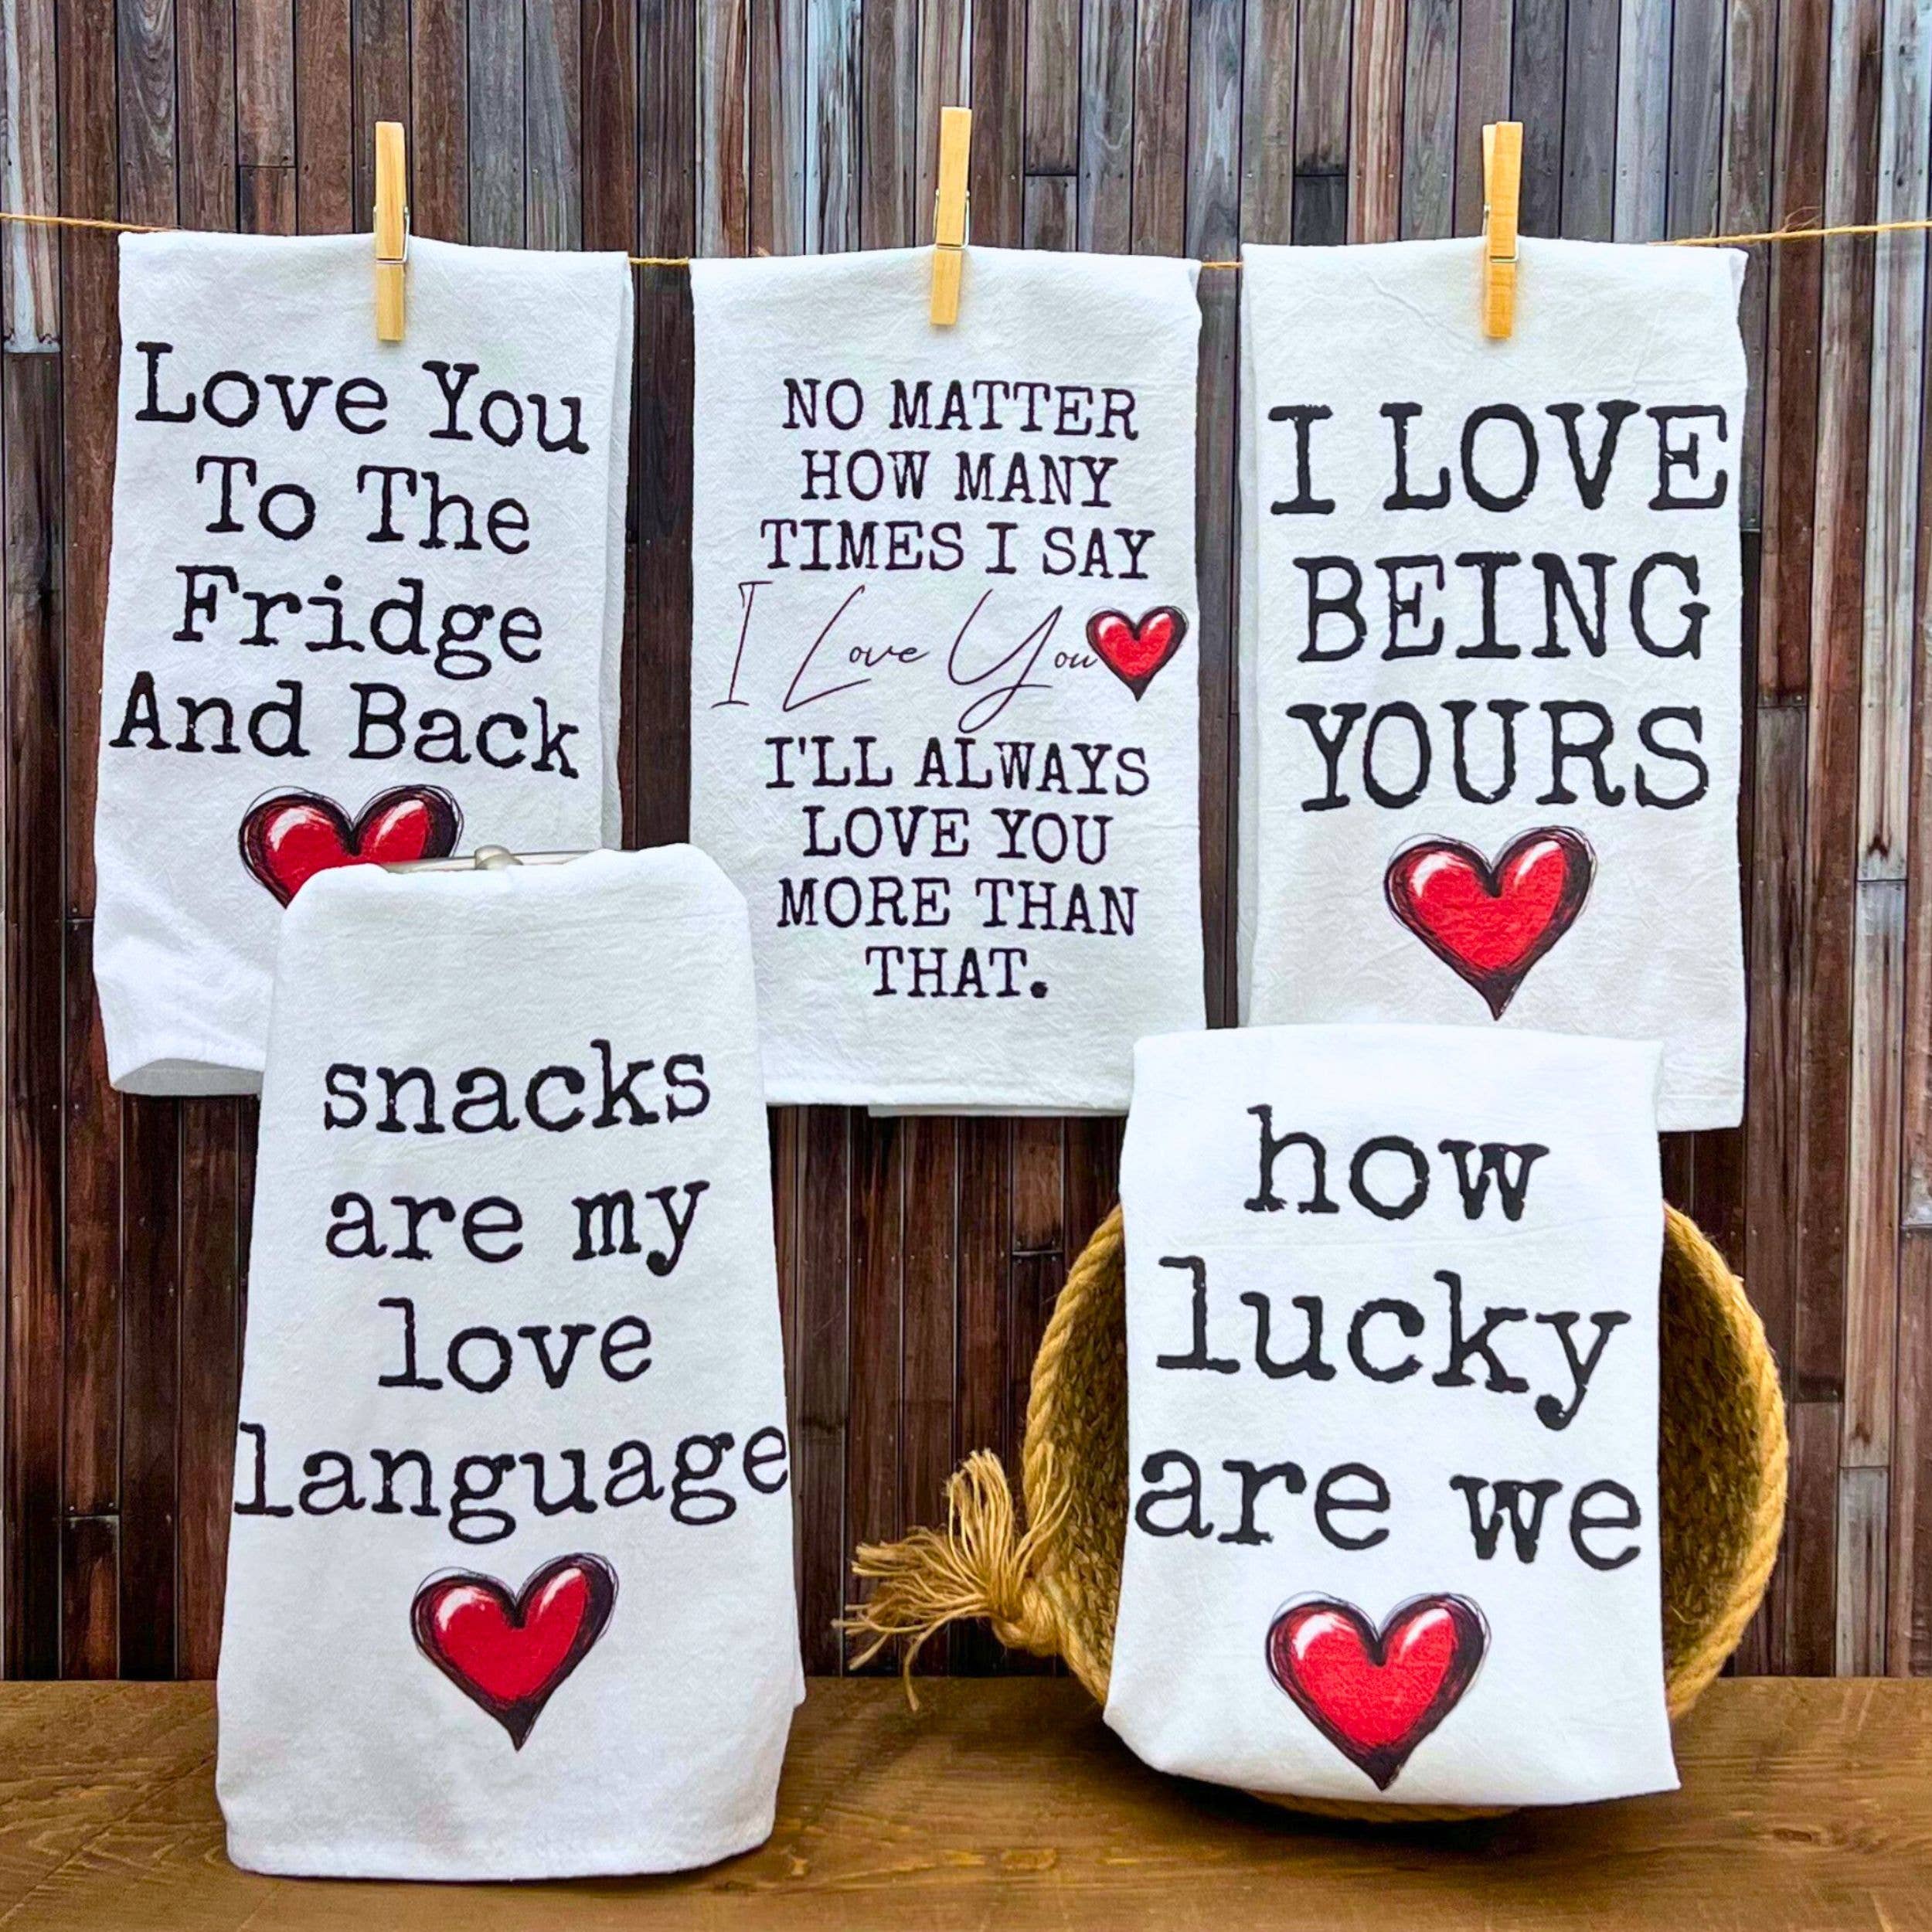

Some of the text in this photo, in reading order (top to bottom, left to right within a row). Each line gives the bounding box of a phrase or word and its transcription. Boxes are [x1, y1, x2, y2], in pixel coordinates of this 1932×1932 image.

[135, 342, 589, 454] Love You
[783, 379, 1138, 440] NO MATTER
[196, 455, 530, 555] To The
[801, 450, 1117, 507] HOW MANY
[1269, 400, 1727, 515] I LOVE
[761, 519, 1155, 579] TIMES I SAY
[173, 566, 542, 680] Fridge
[713, 581, 1097, 733] I Love You
[1294, 552, 1709, 662] BEING
[109, 672, 579, 779] And Back
[765, 736, 1148, 796] I'LL ALWAYS
[1287, 699, 1708, 811] YOURS
[802, 805, 1114, 864] LOVE YOU
[777, 876, 1139, 935] MORE THAN
[866, 947, 1047, 998] THAT.
[325, 1039, 709, 1134] snacks
[1244, 1105, 1549, 1221] how
[326, 1181, 709, 1277] are my
[379, 1298, 651, 1393] love
[1157, 1257, 1631, 1430] lucky
[233, 1422, 788, 1543] language
[1134, 1451, 1641, 1570] are we
